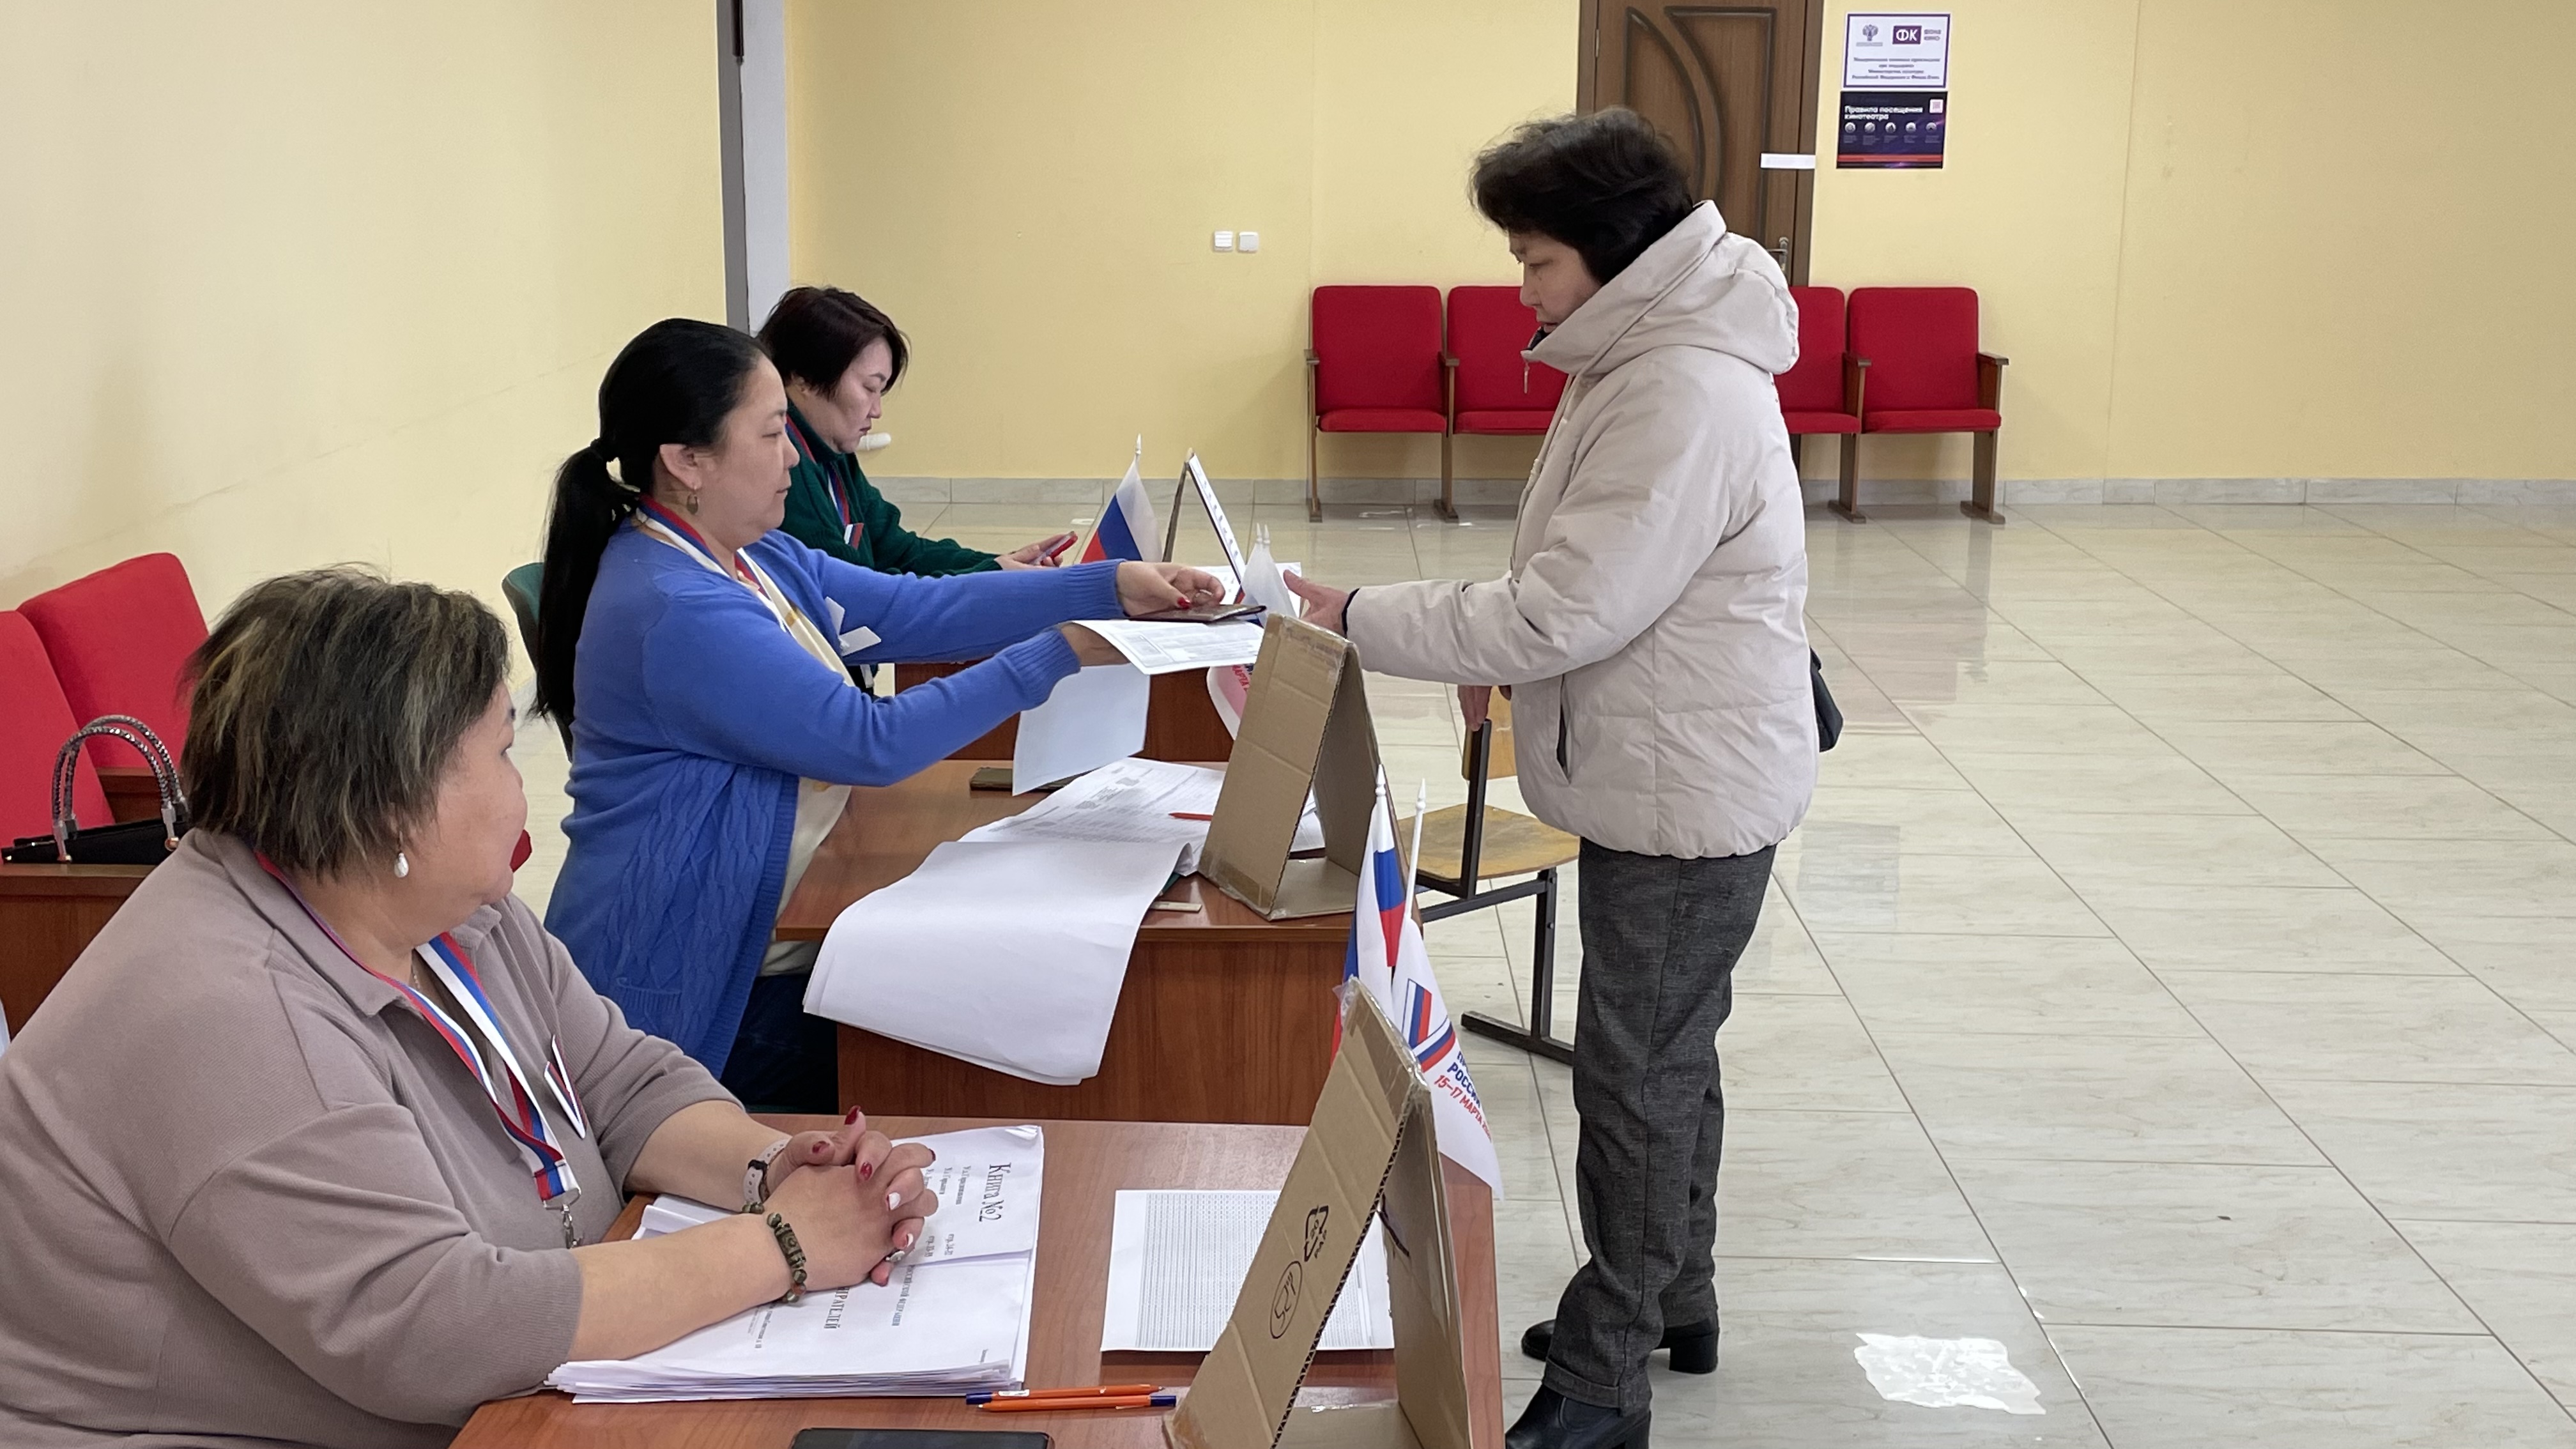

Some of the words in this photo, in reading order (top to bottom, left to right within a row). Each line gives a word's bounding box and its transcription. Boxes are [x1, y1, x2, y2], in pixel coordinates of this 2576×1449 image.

[1896, 29, 1918, 41] ФК
[1459, 1094, 1482, 1124] МАРТА
[983, 1163, 1011, 1199] Книга
